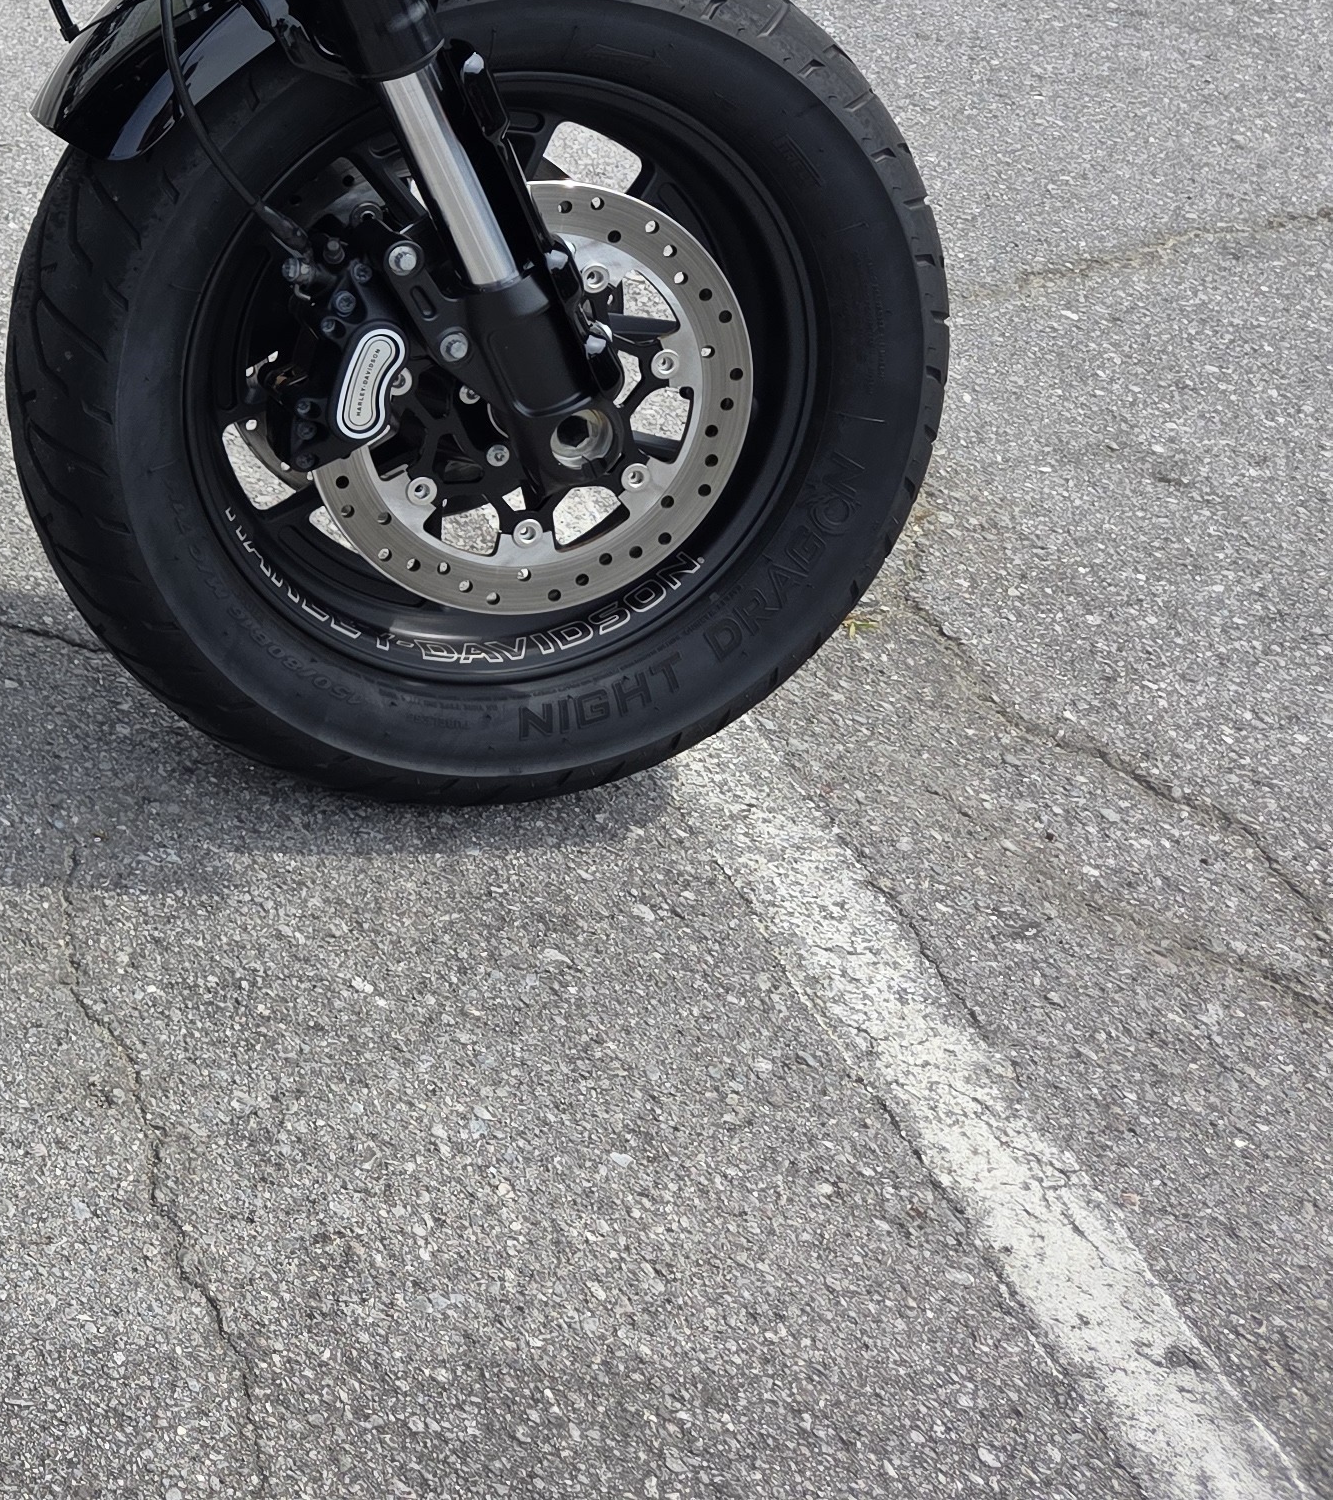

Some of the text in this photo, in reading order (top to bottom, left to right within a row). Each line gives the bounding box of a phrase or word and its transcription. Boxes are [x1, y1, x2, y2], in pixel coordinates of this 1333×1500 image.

[356, 348, 381, 417] HARLEY-DAVIDSON
[517, 653, 683, 742] NIGHT
[701, 450, 866, 663] DRAGON
